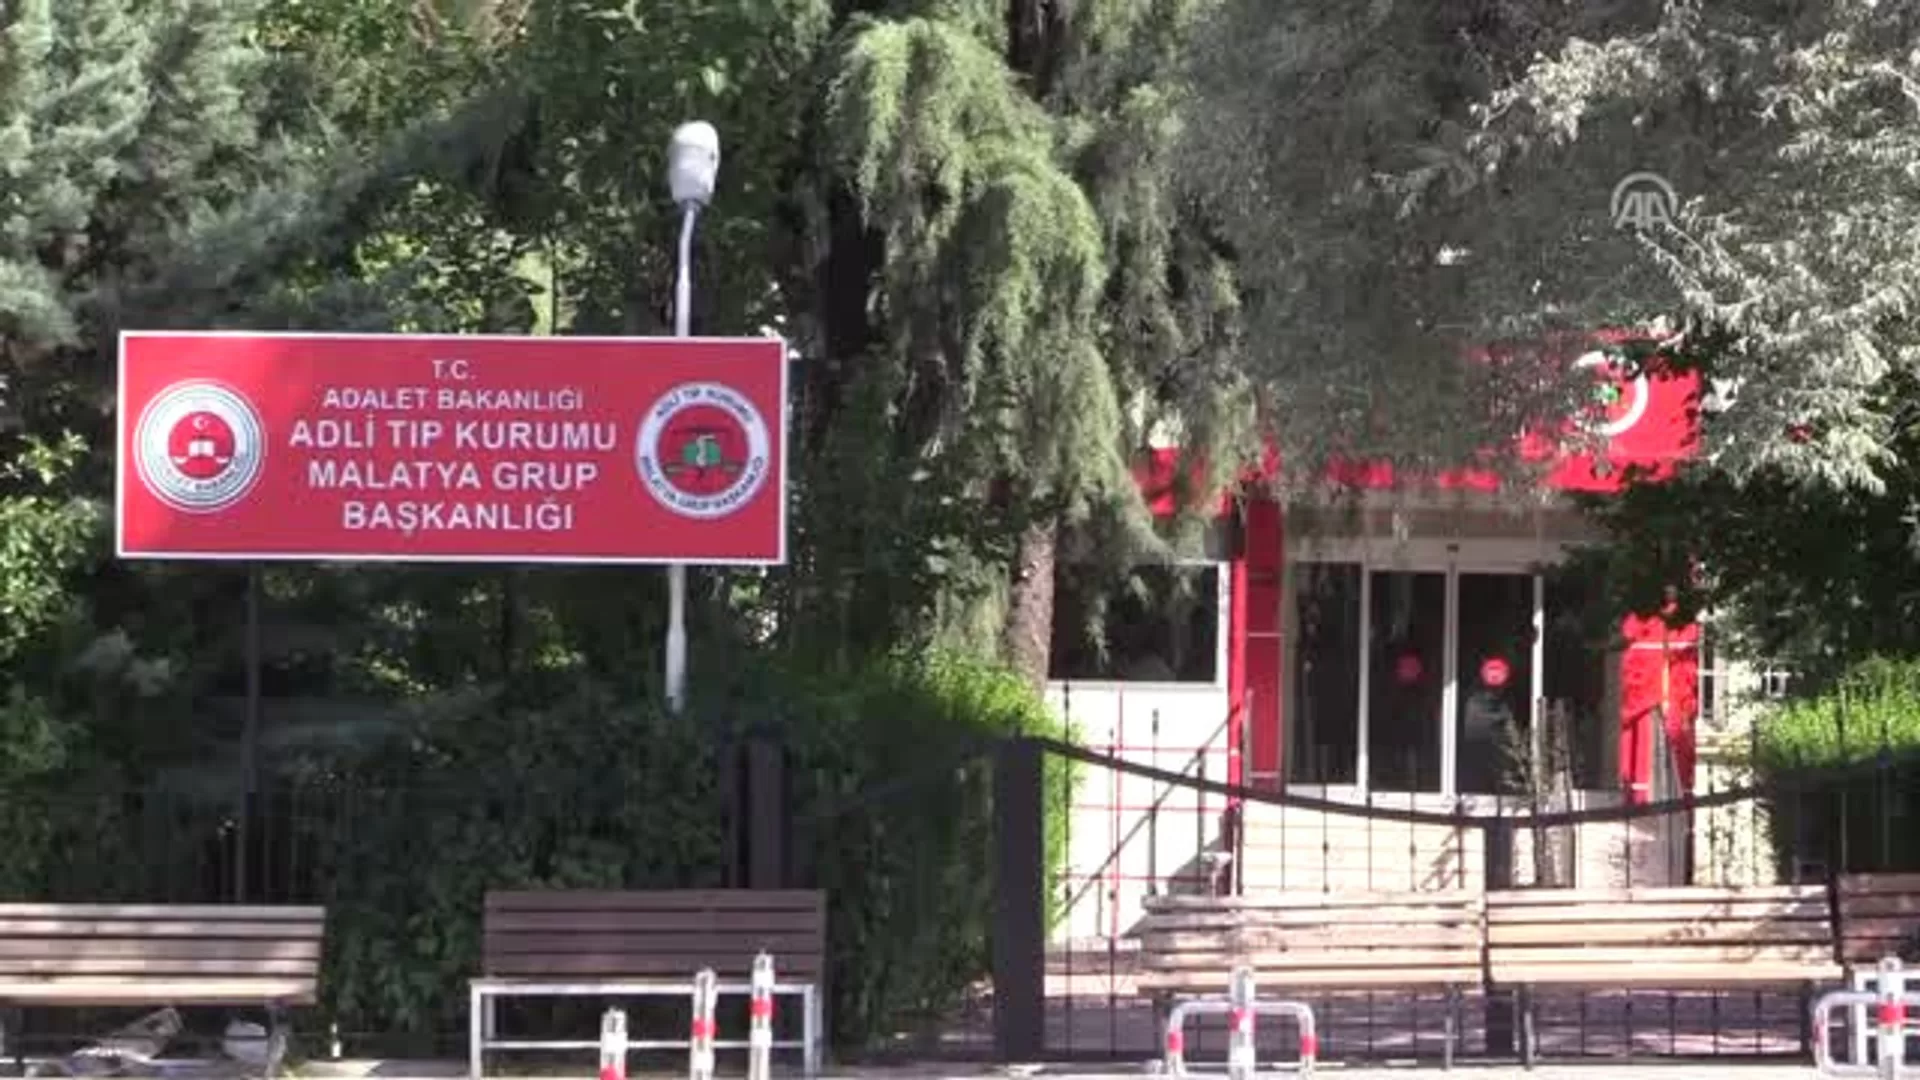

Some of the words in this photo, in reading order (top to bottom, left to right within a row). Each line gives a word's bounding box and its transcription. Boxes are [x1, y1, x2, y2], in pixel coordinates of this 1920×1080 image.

[432, 360, 477, 380] T.C.
[323, 388, 429, 410] ADALET
[437, 385, 583, 410] BAKANLIĞI
[289, 412, 375, 448] ADLİ
[386, 420, 443, 448] TIP
[455, 420, 617, 450] KURUMU
[308, 460, 482, 489] MALATYA
[492, 461, 598, 490] GRUP
[343, 496, 573, 538] BAŞKANLIĞI
